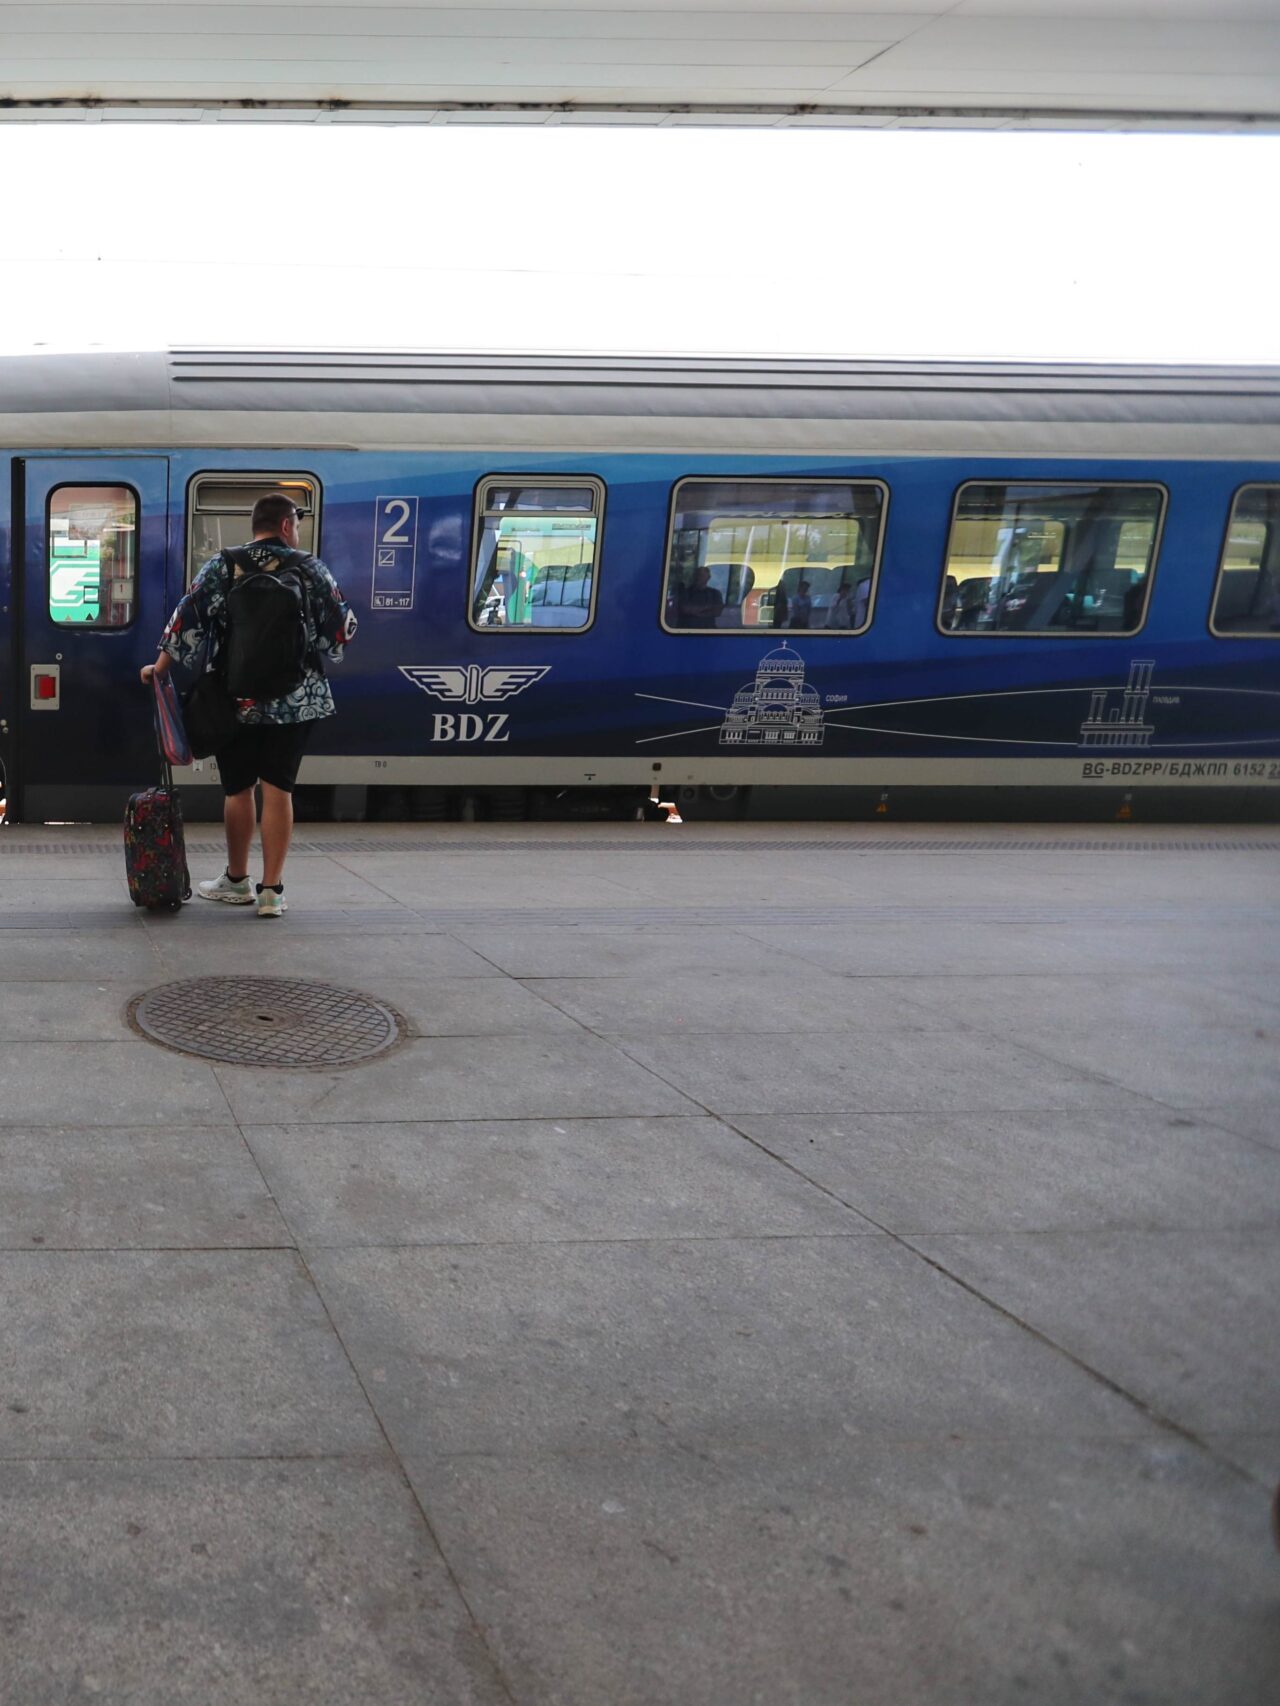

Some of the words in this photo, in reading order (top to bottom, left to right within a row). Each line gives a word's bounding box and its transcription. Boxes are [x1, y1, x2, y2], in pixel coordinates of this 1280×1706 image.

[382, 499, 410, 543] 2
[385, 597, 394, 606] 81
[399, 597, 410, 606] 117
[430, 713, 510, 742] BDZ
[1233, 763, 1265, 776] 6152
